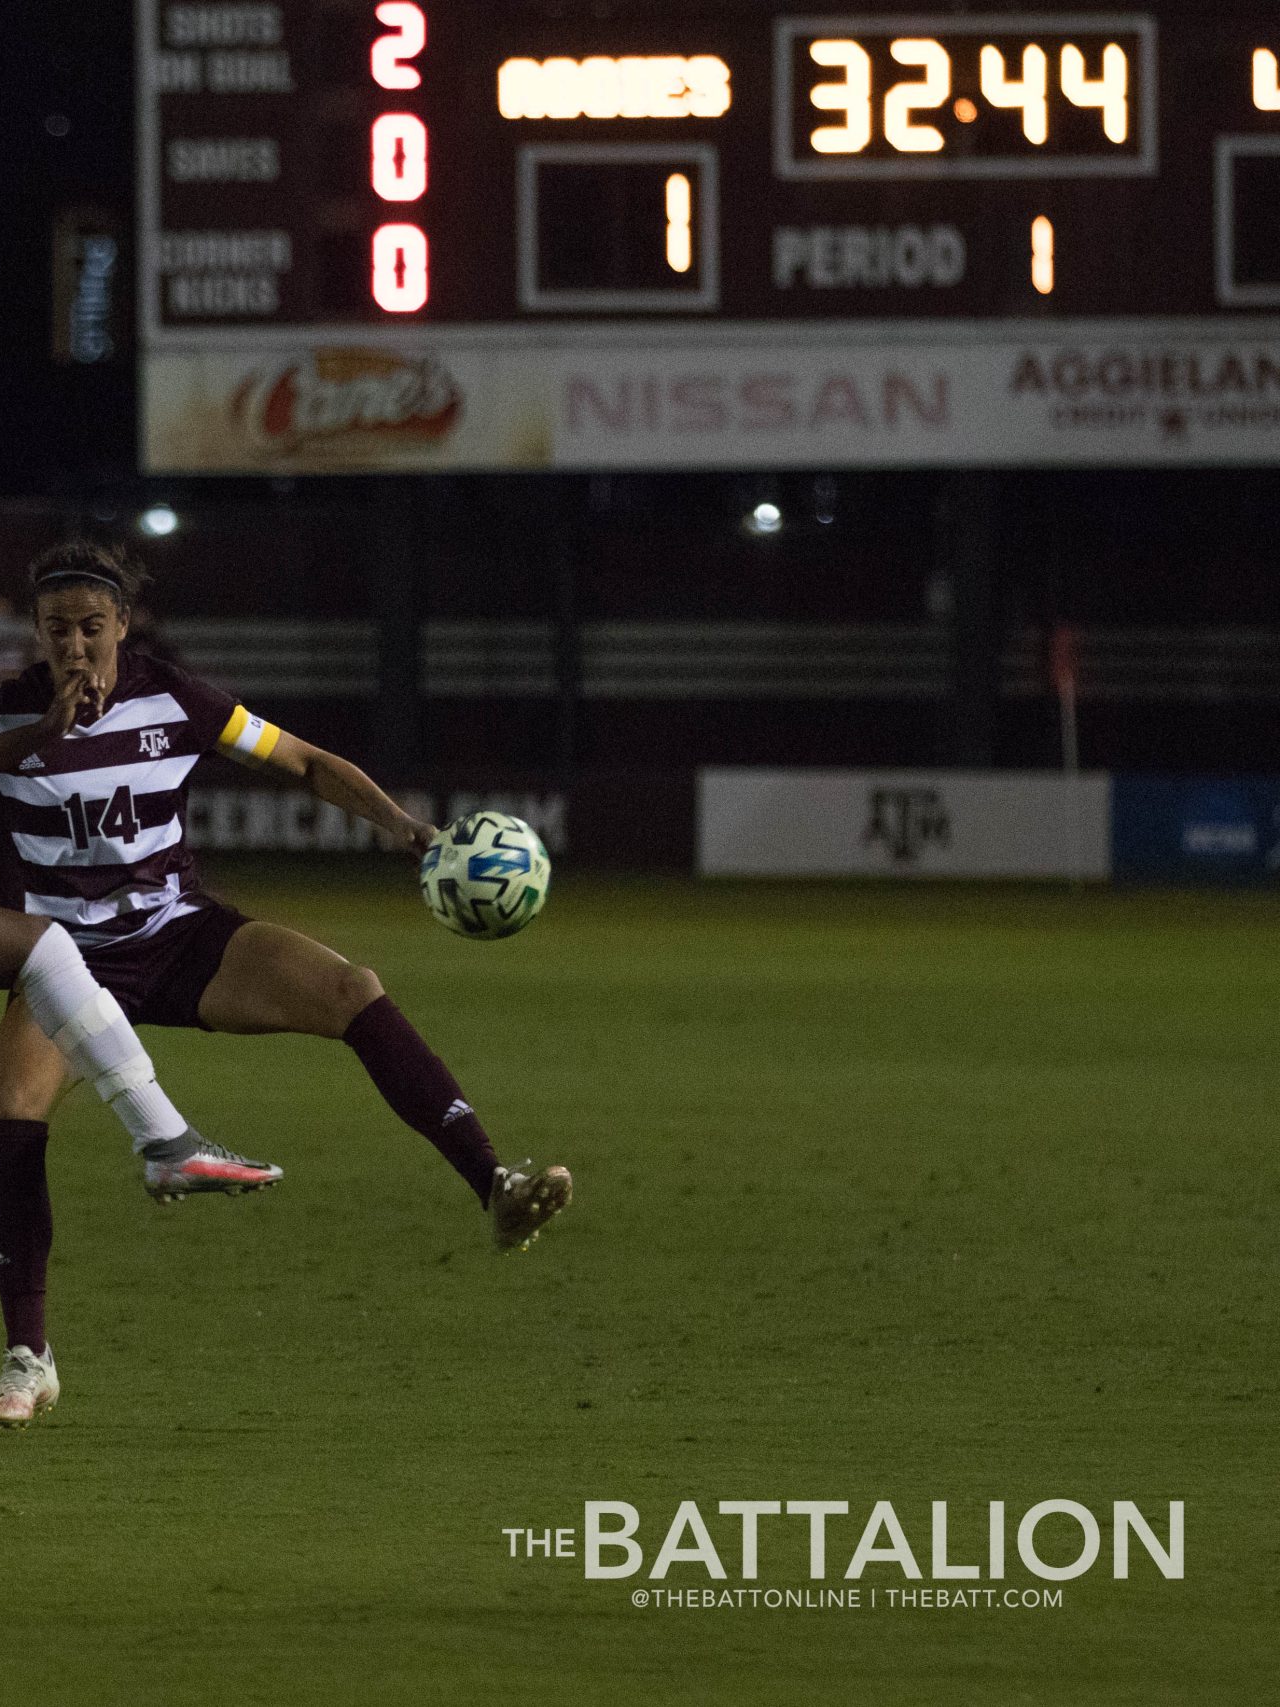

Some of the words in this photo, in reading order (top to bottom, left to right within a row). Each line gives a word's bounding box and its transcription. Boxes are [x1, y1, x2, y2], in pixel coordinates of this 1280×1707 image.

[371, 2, 426, 90] 2
[372, 113, 427, 201] 0
[666, 172, 691, 273] 1
[772, 223, 967, 289] PERIOD
[1031, 214, 1054, 295] 1
[372, 223, 428, 312] 0
[565, 374, 951, 432] NISSAN
[62, 784, 141, 850] 14
